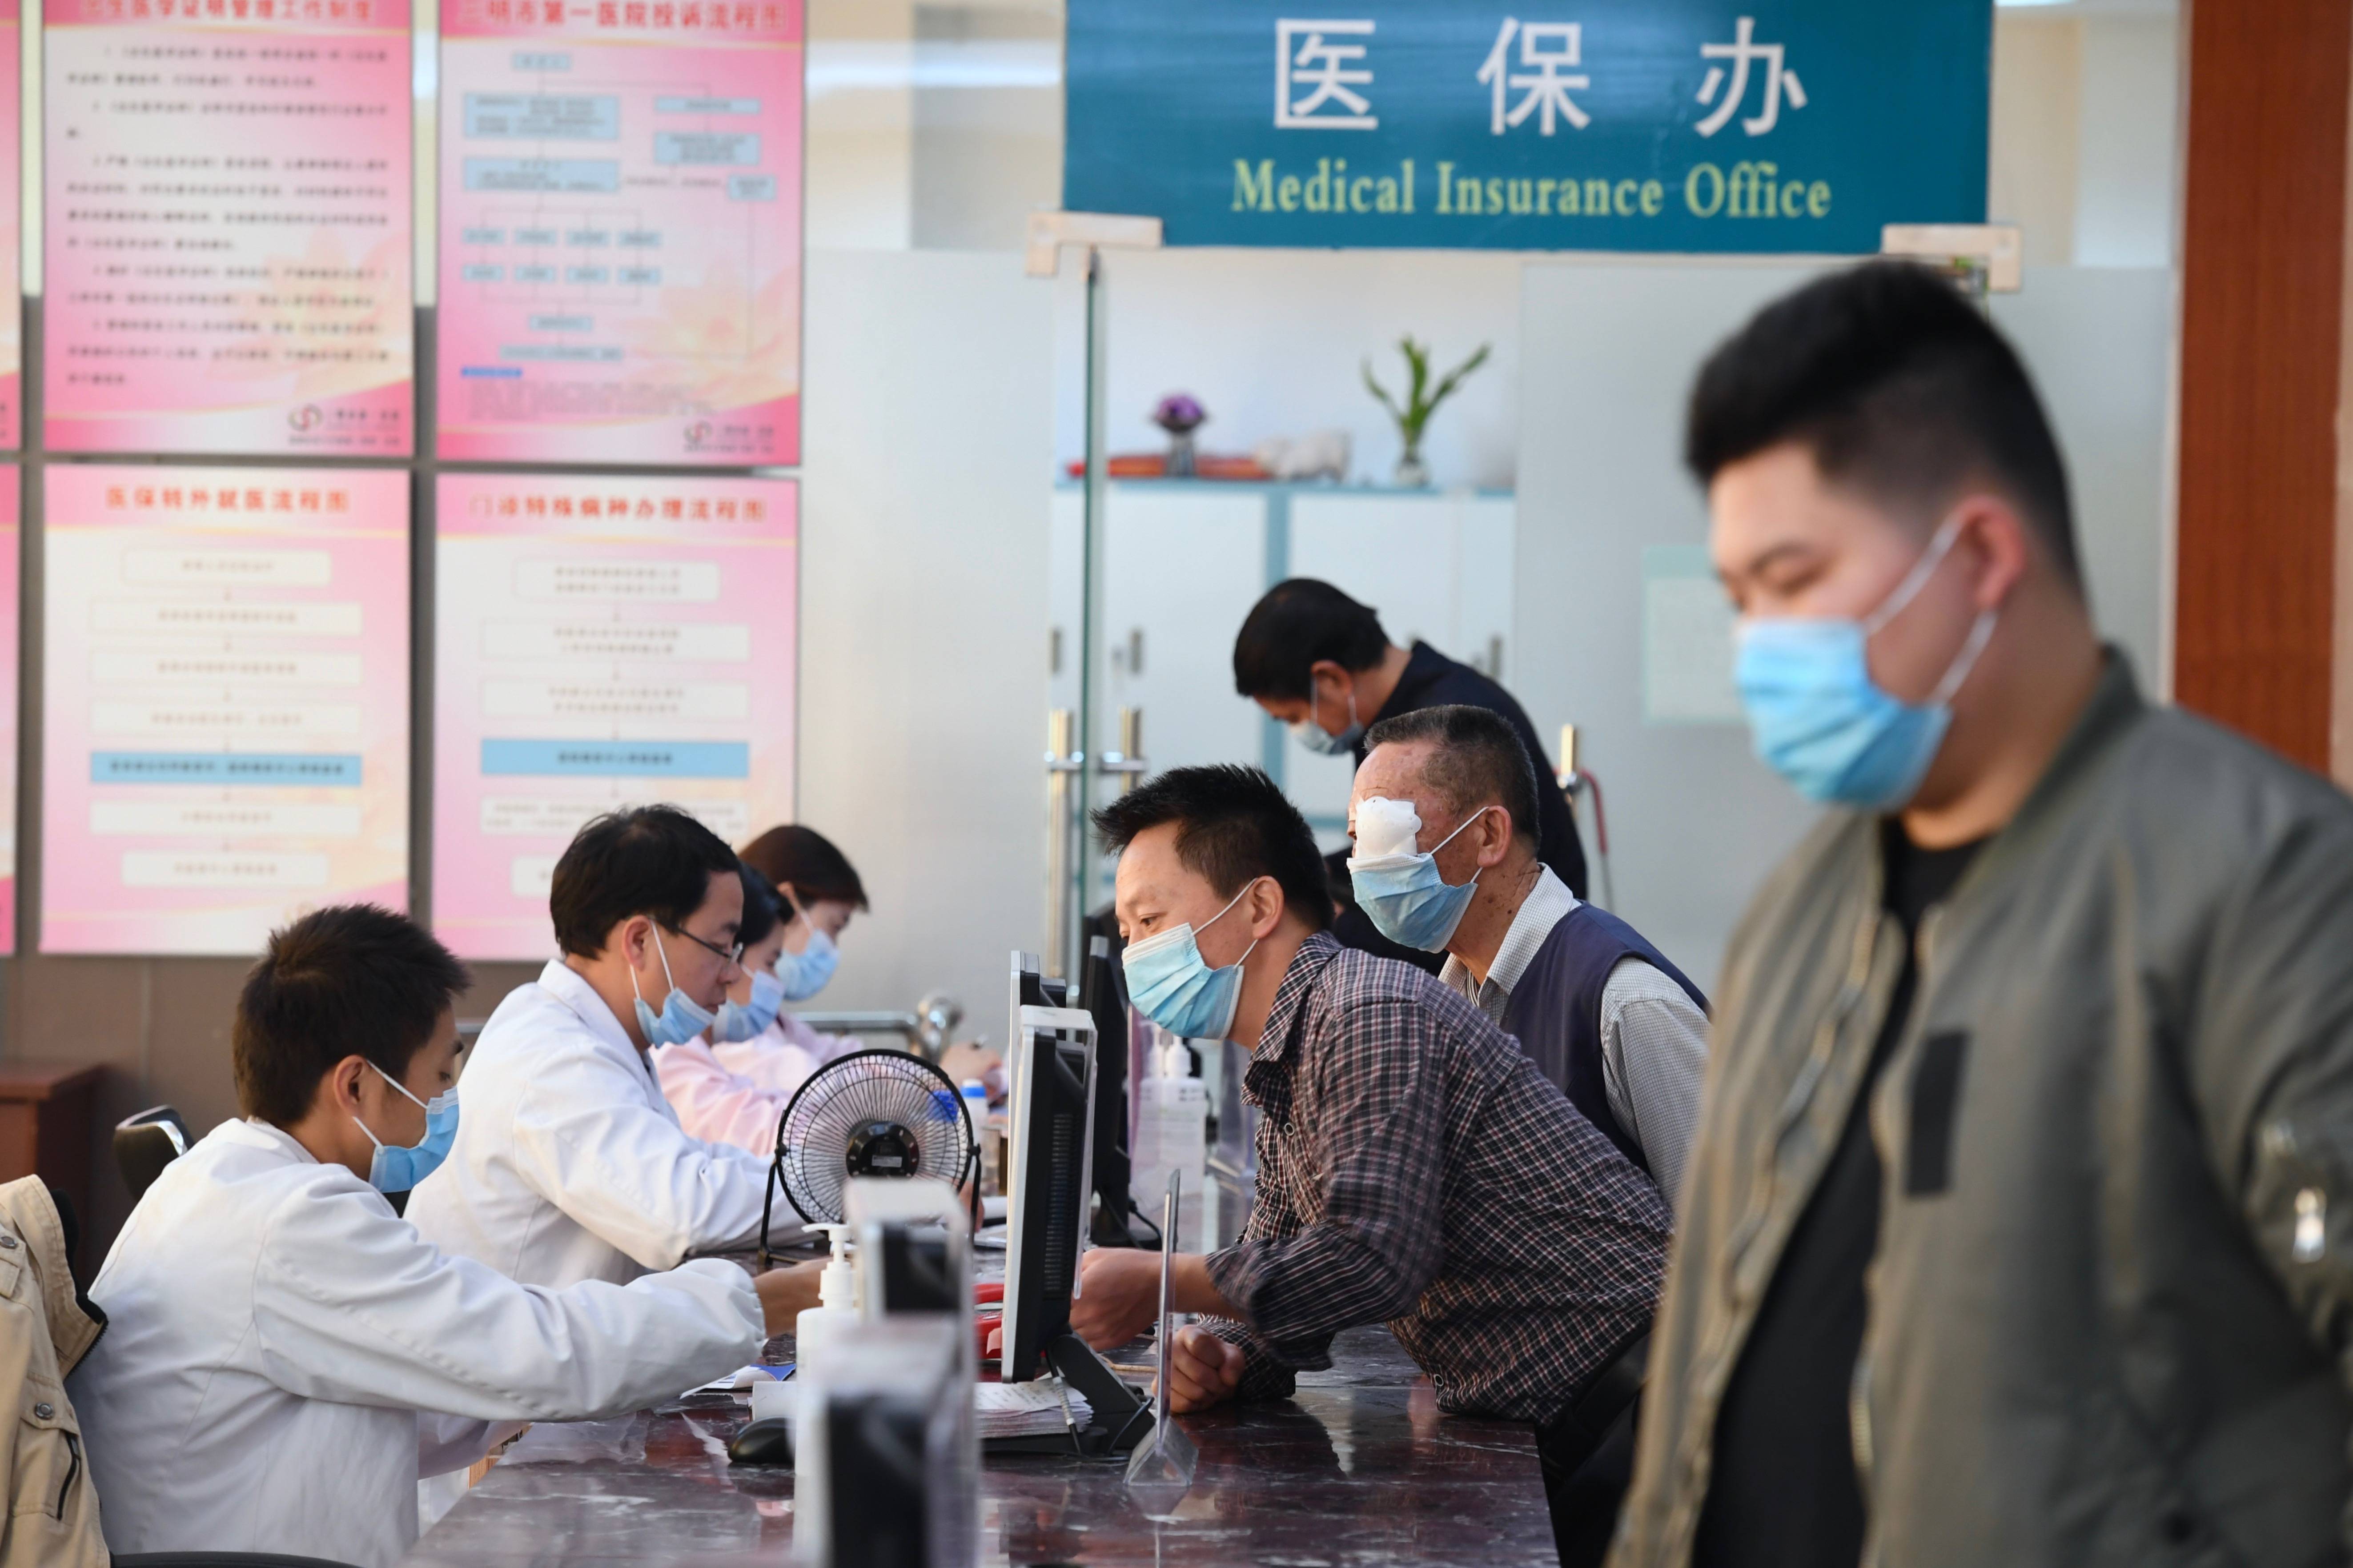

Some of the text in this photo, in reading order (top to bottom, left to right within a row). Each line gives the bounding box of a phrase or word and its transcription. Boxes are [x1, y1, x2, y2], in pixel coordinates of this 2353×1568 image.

[1274, 16, 1807, 138] 医保办
[1232, 158, 1831, 218] Medical Insurance Office
